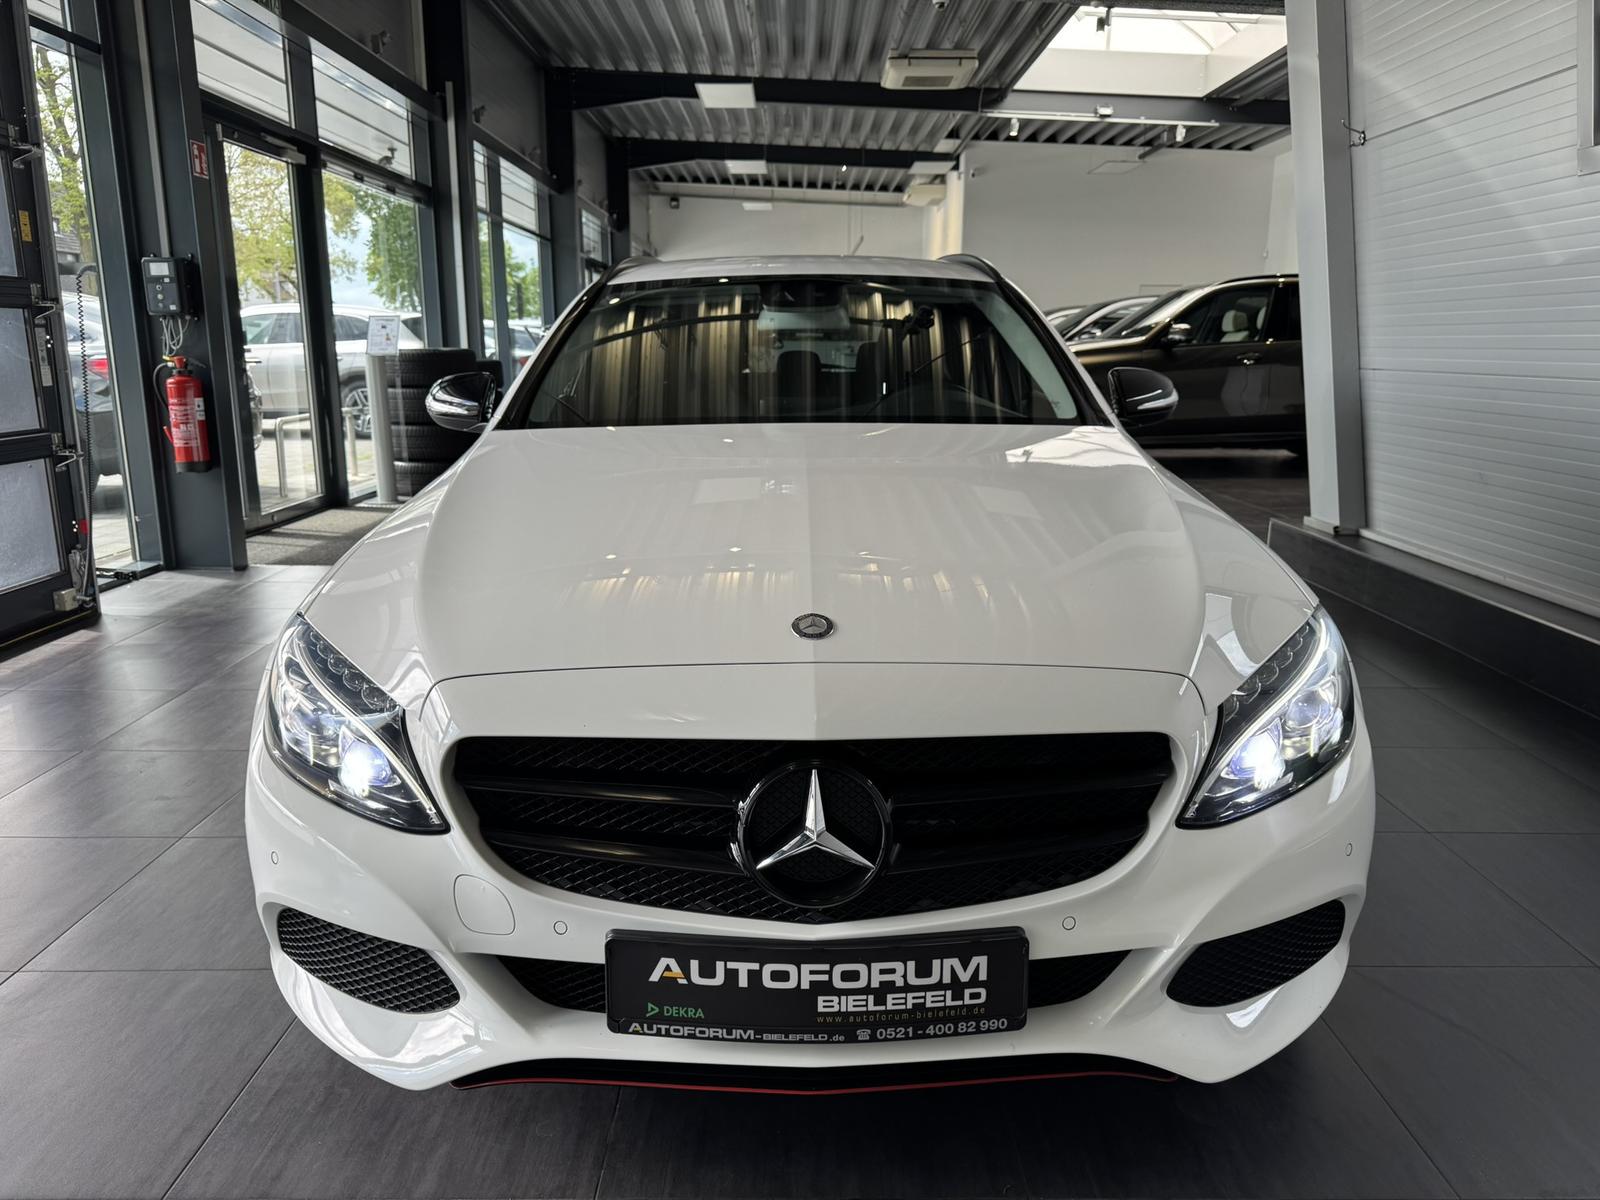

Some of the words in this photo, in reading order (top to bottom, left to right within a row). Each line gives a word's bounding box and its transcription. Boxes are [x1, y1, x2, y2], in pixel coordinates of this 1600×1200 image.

[648, 955, 988, 989] AUTOFORUM
[817, 987, 987, 1013] BIELEFELD
[663, 1005, 705, 1019] DEKRA
[816, 1006, 986, 1023] www.autoforum-bielefeld.de
[958, 1020, 977, 1033] 82
[979, 1018, 1008, 1031] 990
